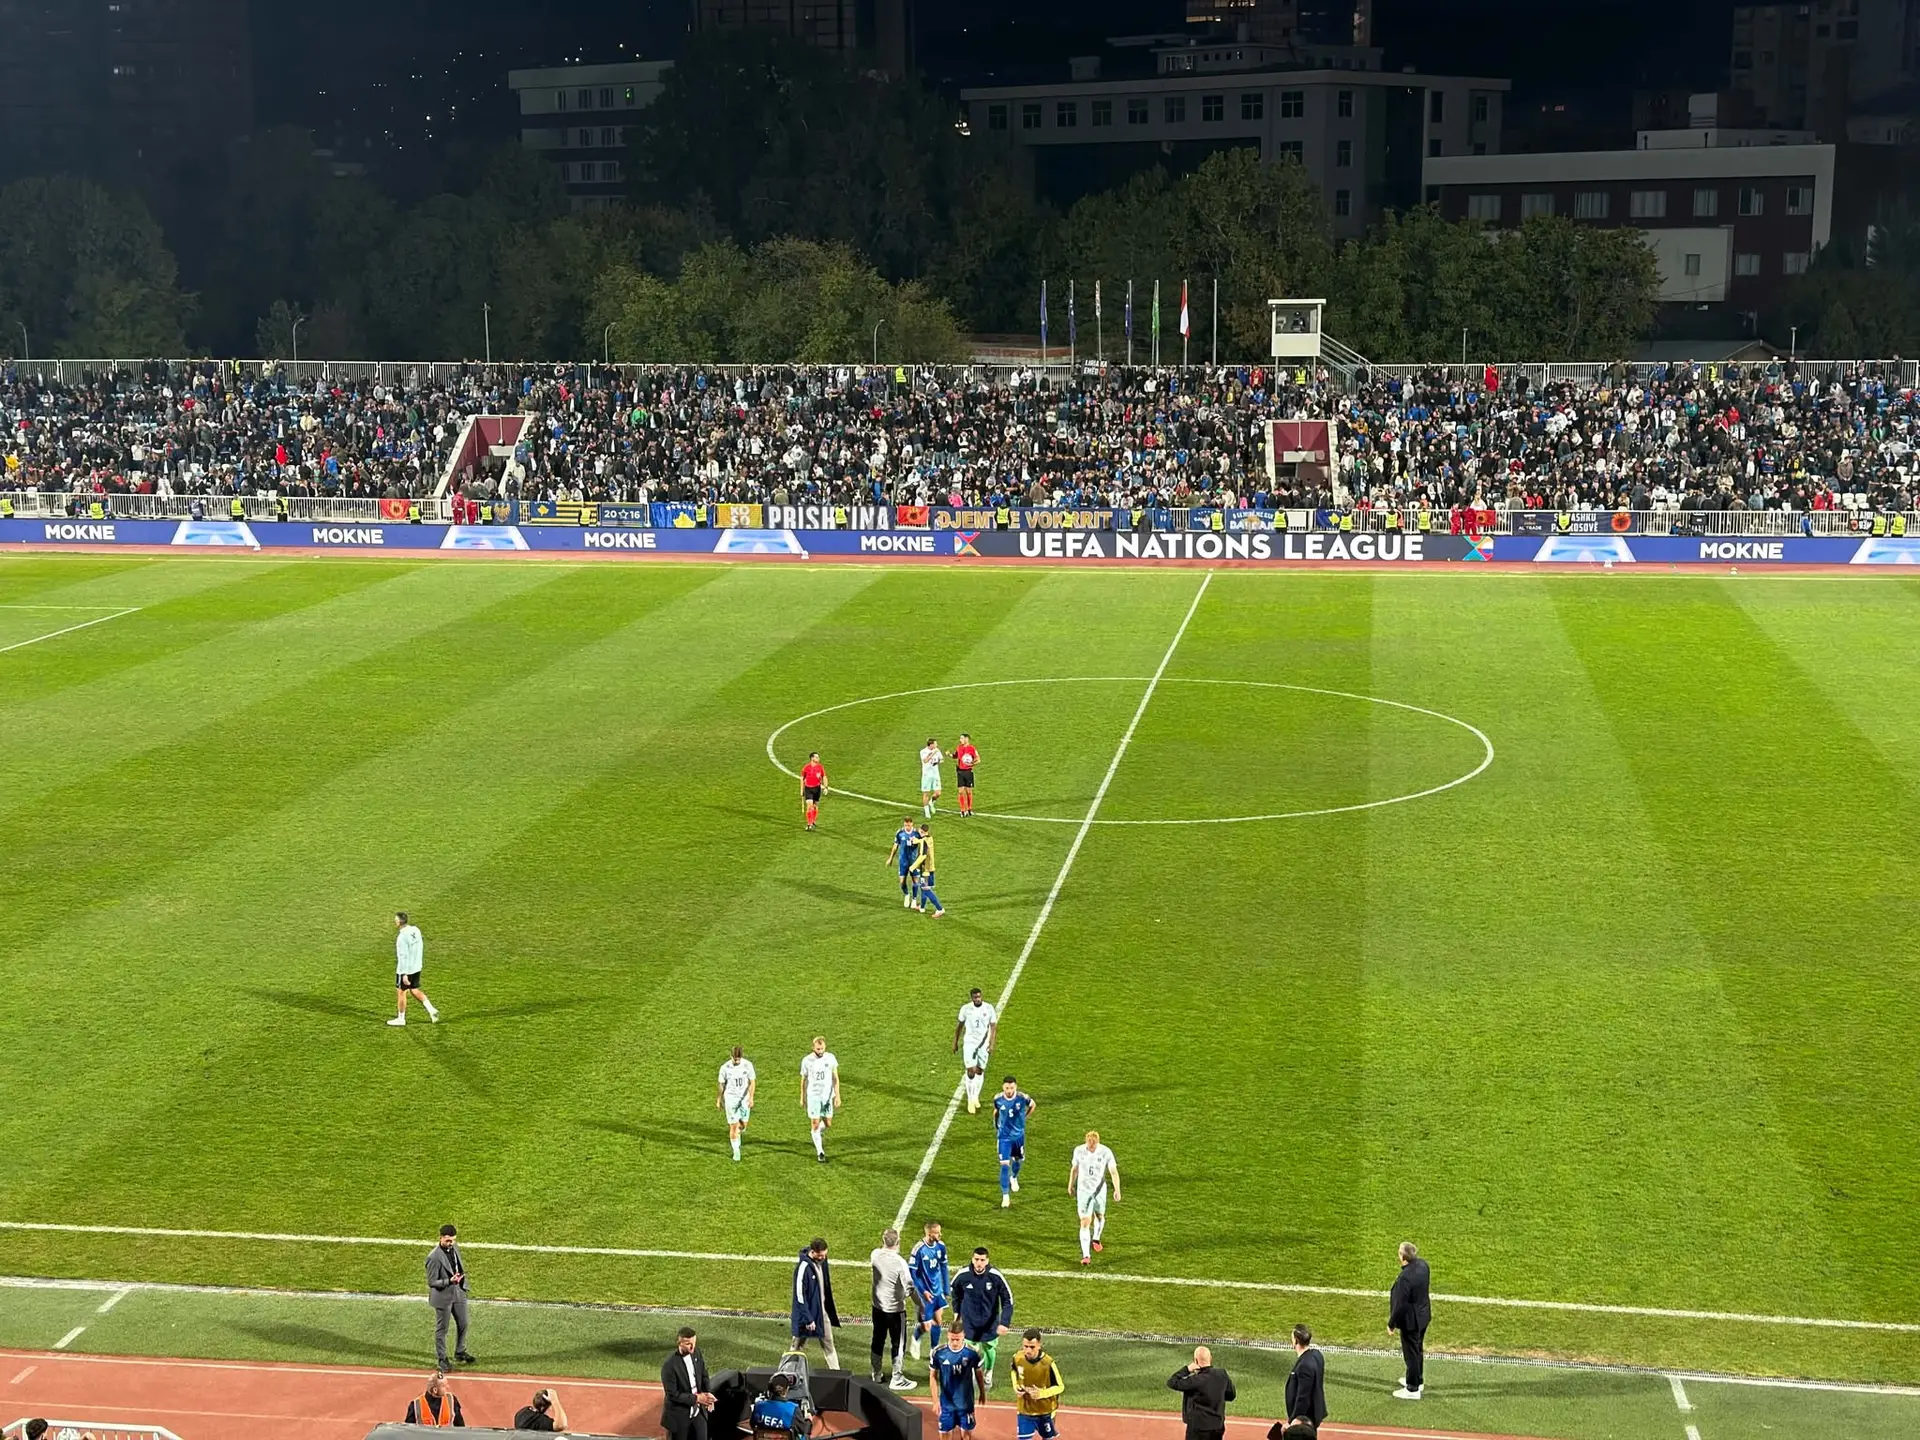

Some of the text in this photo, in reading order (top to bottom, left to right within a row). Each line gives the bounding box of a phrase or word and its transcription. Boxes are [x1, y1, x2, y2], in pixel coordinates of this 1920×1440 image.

[604, 510, 640, 519] 20 16
[730, 505, 750, 516] KO
[768, 505, 889, 530] PRISHINA
[730, 516, 750, 527] SO
[45, 523, 115, 541] MOKNE
[313, 527, 384, 545] MOKNE
[584, 532, 656, 549] MOKNE
[861, 535, 934, 552] MOKNE
[1019, 532, 1425, 561] UEFA NATIONS LEAGUE
[1700, 542, 1784, 560] MOKNE
[816, 1071, 825, 1081] 20
